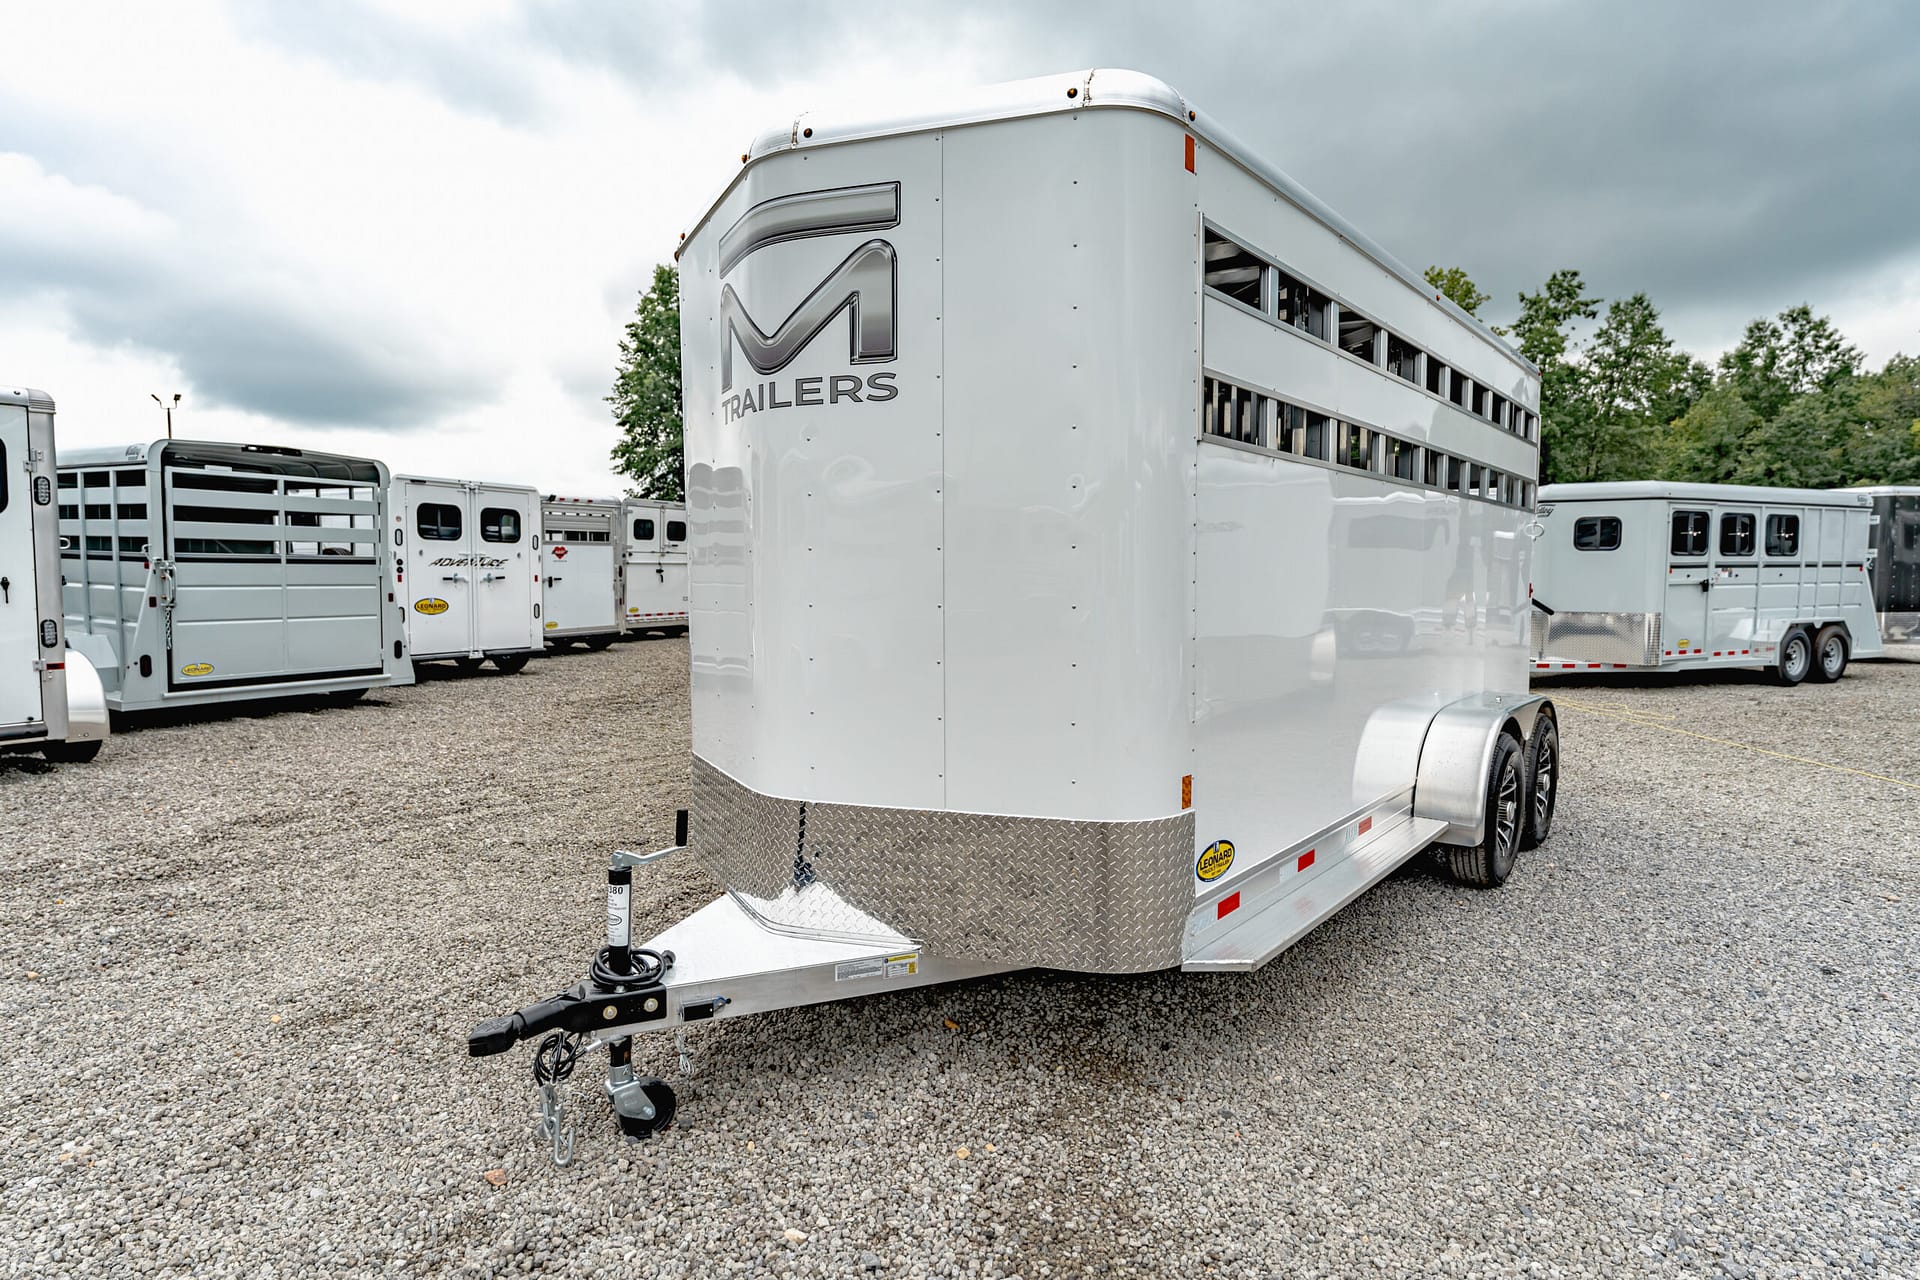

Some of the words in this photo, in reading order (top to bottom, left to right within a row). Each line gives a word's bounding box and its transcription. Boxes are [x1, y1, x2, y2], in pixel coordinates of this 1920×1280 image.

[722, 372, 899, 425] TRAILERS
[429, 556, 509, 568] ADVENTURE
[1199, 848, 1232, 870] LEONARD
